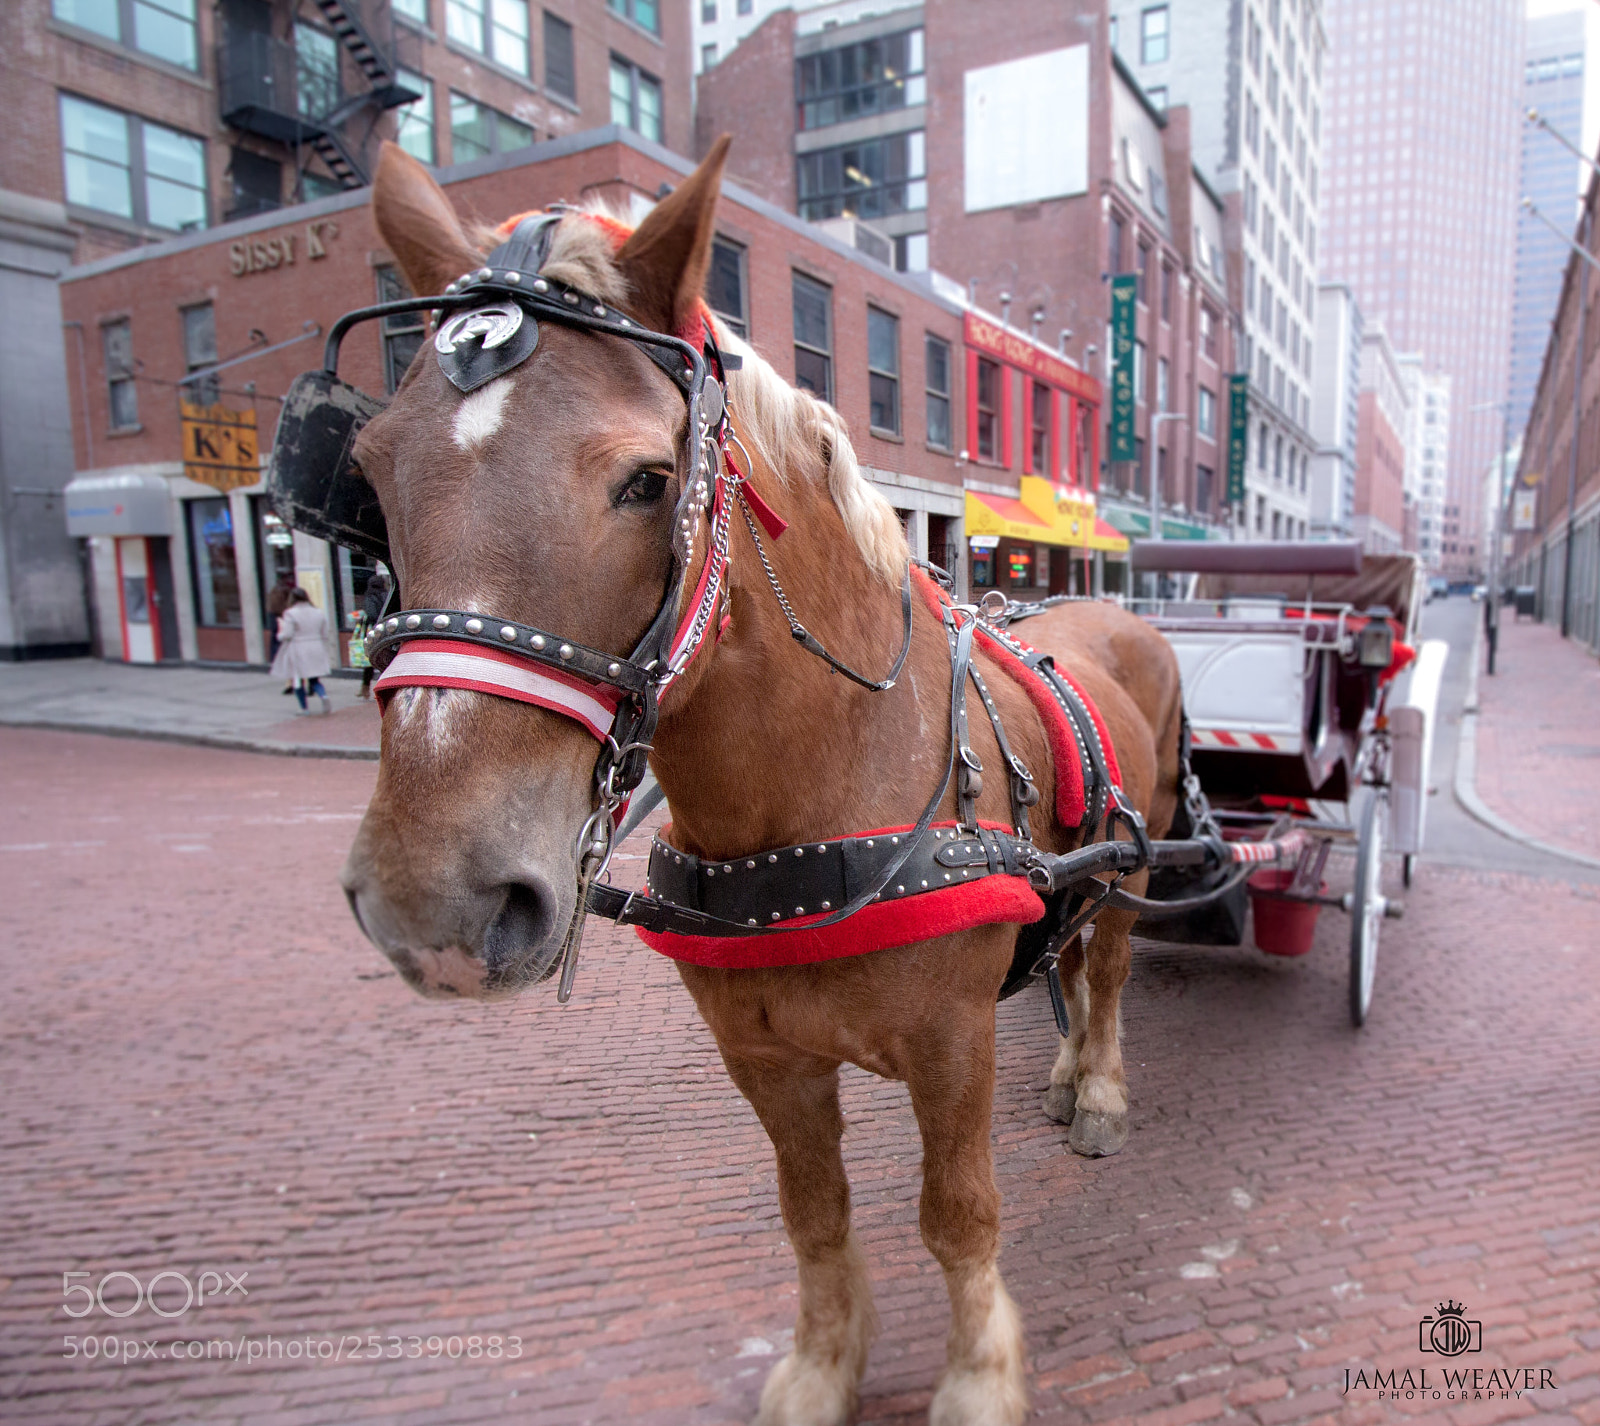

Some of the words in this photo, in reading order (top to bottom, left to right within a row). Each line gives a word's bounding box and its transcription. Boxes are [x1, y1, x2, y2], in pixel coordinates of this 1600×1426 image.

[1114, 287, 1134, 353] WILD
[1117, 371, 1131, 450] ROVER
[192, 427, 253, 461] K's
